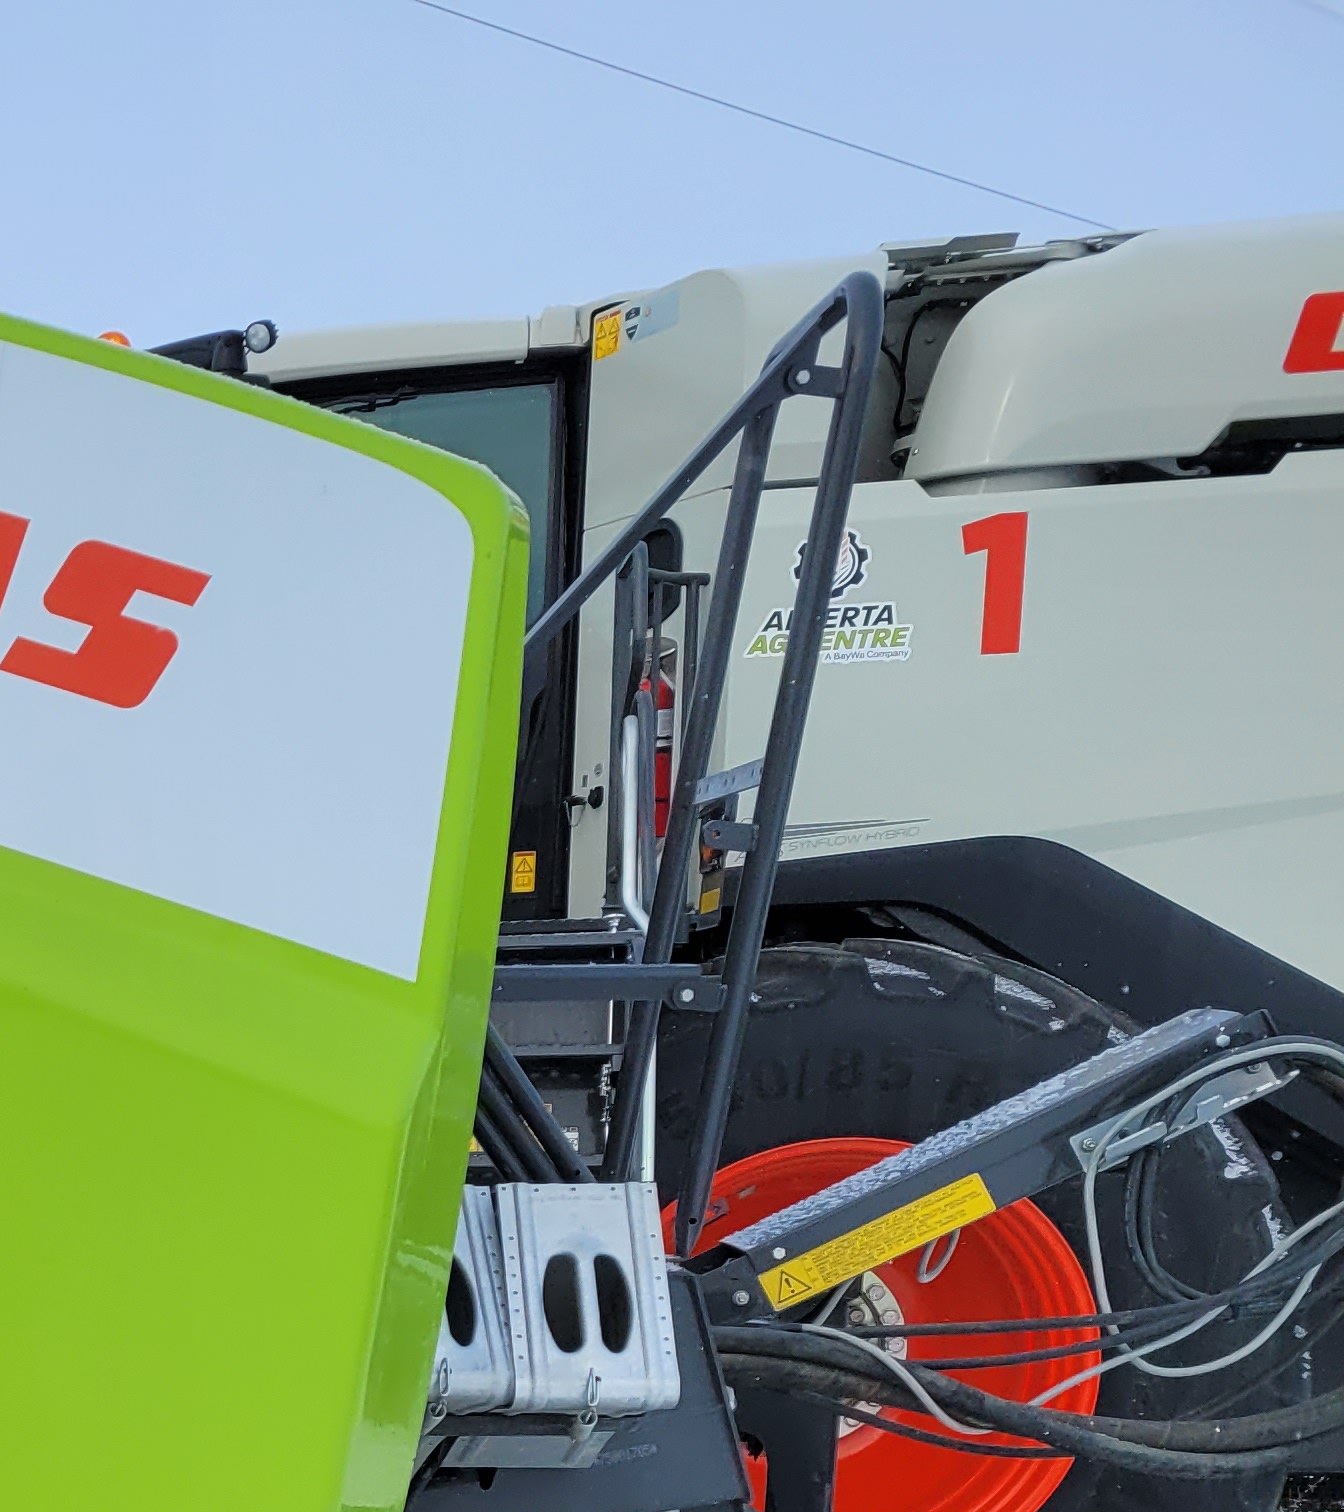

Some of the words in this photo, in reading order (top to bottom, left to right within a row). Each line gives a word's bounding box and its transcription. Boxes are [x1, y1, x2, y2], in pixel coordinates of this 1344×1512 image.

[961, 511, 1028, 656] 1
[761, 604, 893, 633] AERTA
[865, 826, 920, 842] HYBRID
